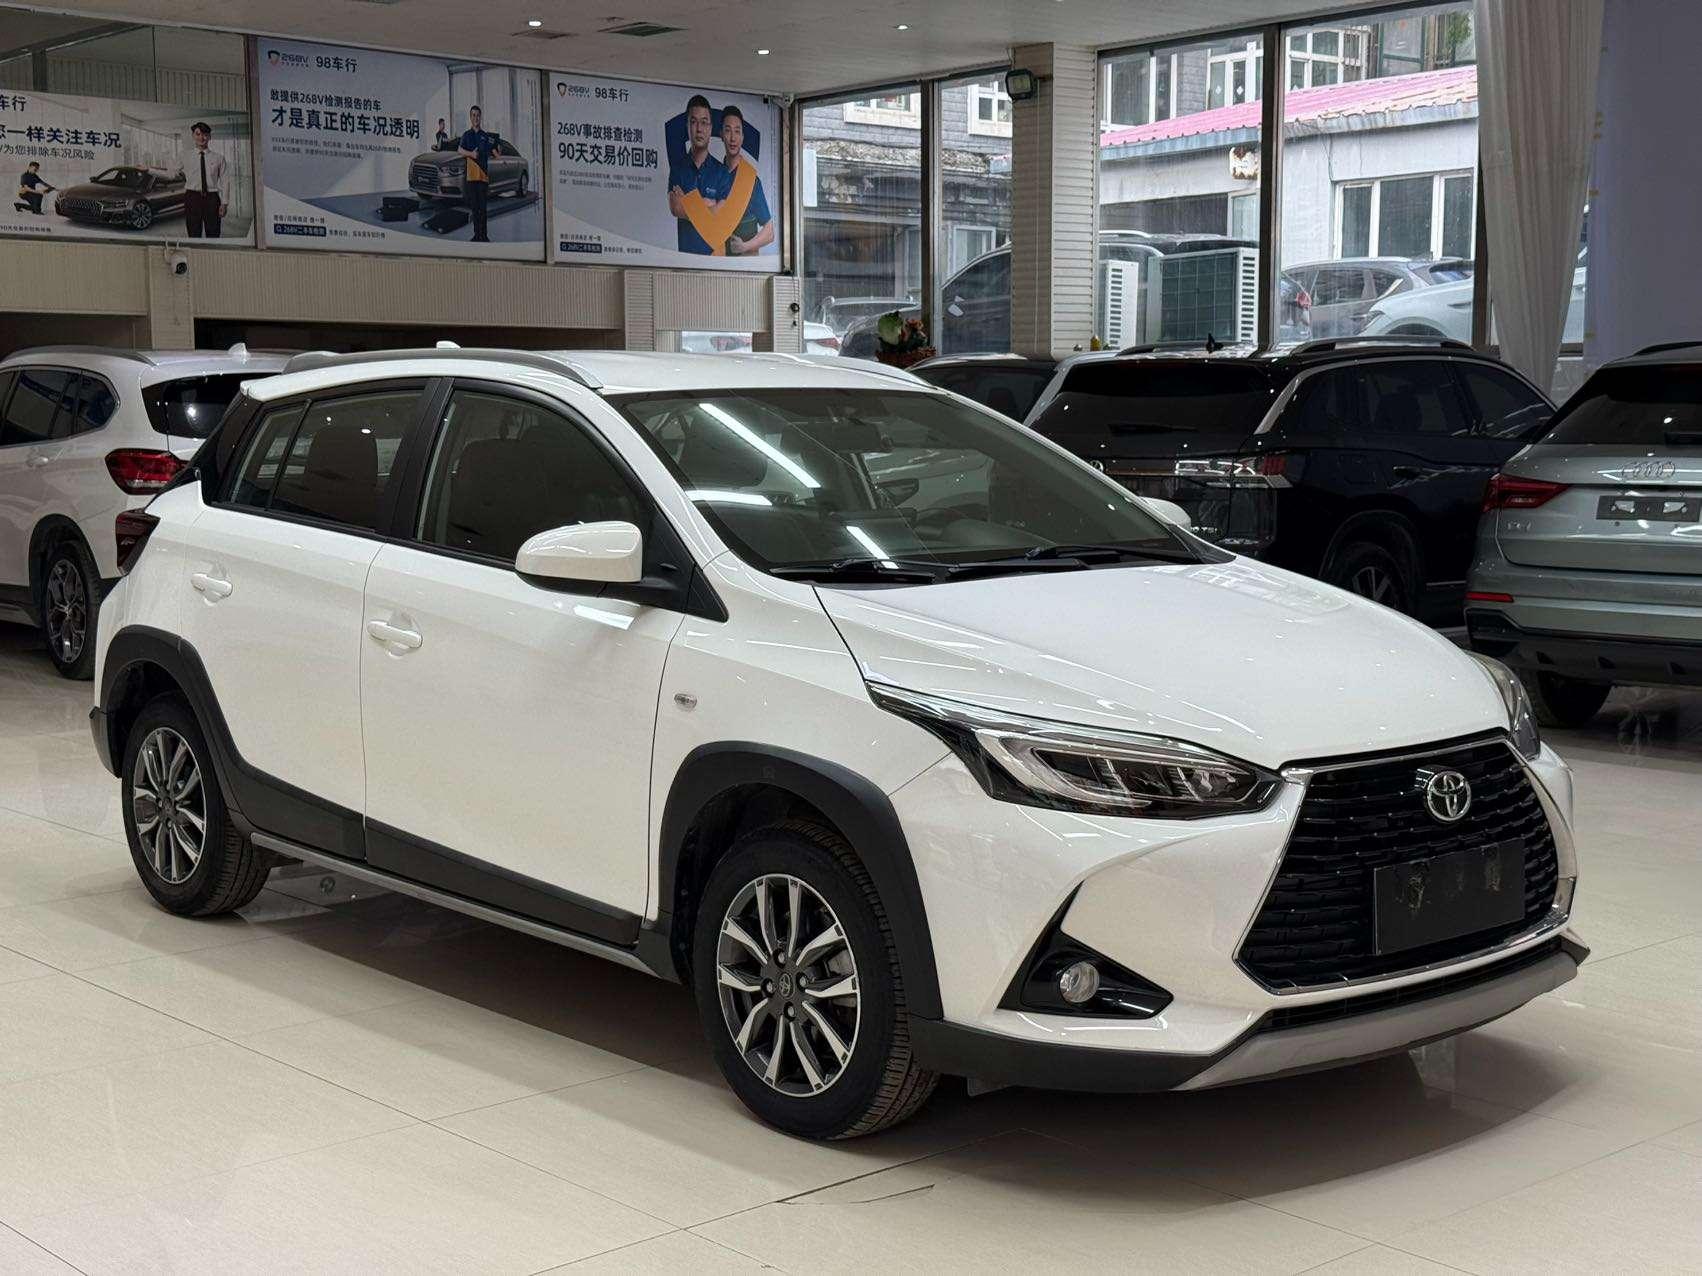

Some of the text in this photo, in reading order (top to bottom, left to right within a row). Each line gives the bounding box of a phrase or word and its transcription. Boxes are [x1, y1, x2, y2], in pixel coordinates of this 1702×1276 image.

[316, 55, 358, 73] 98车行
[270, 88, 383, 112] 敢提供268V检测报告的车
[594, 87, 629, 102] 98车行
[271, 106, 420, 140] 才是真正的车况透明
[557, 122, 643, 144] 268V事故排查检测
[558, 142, 658, 169] 90天交易价回购
